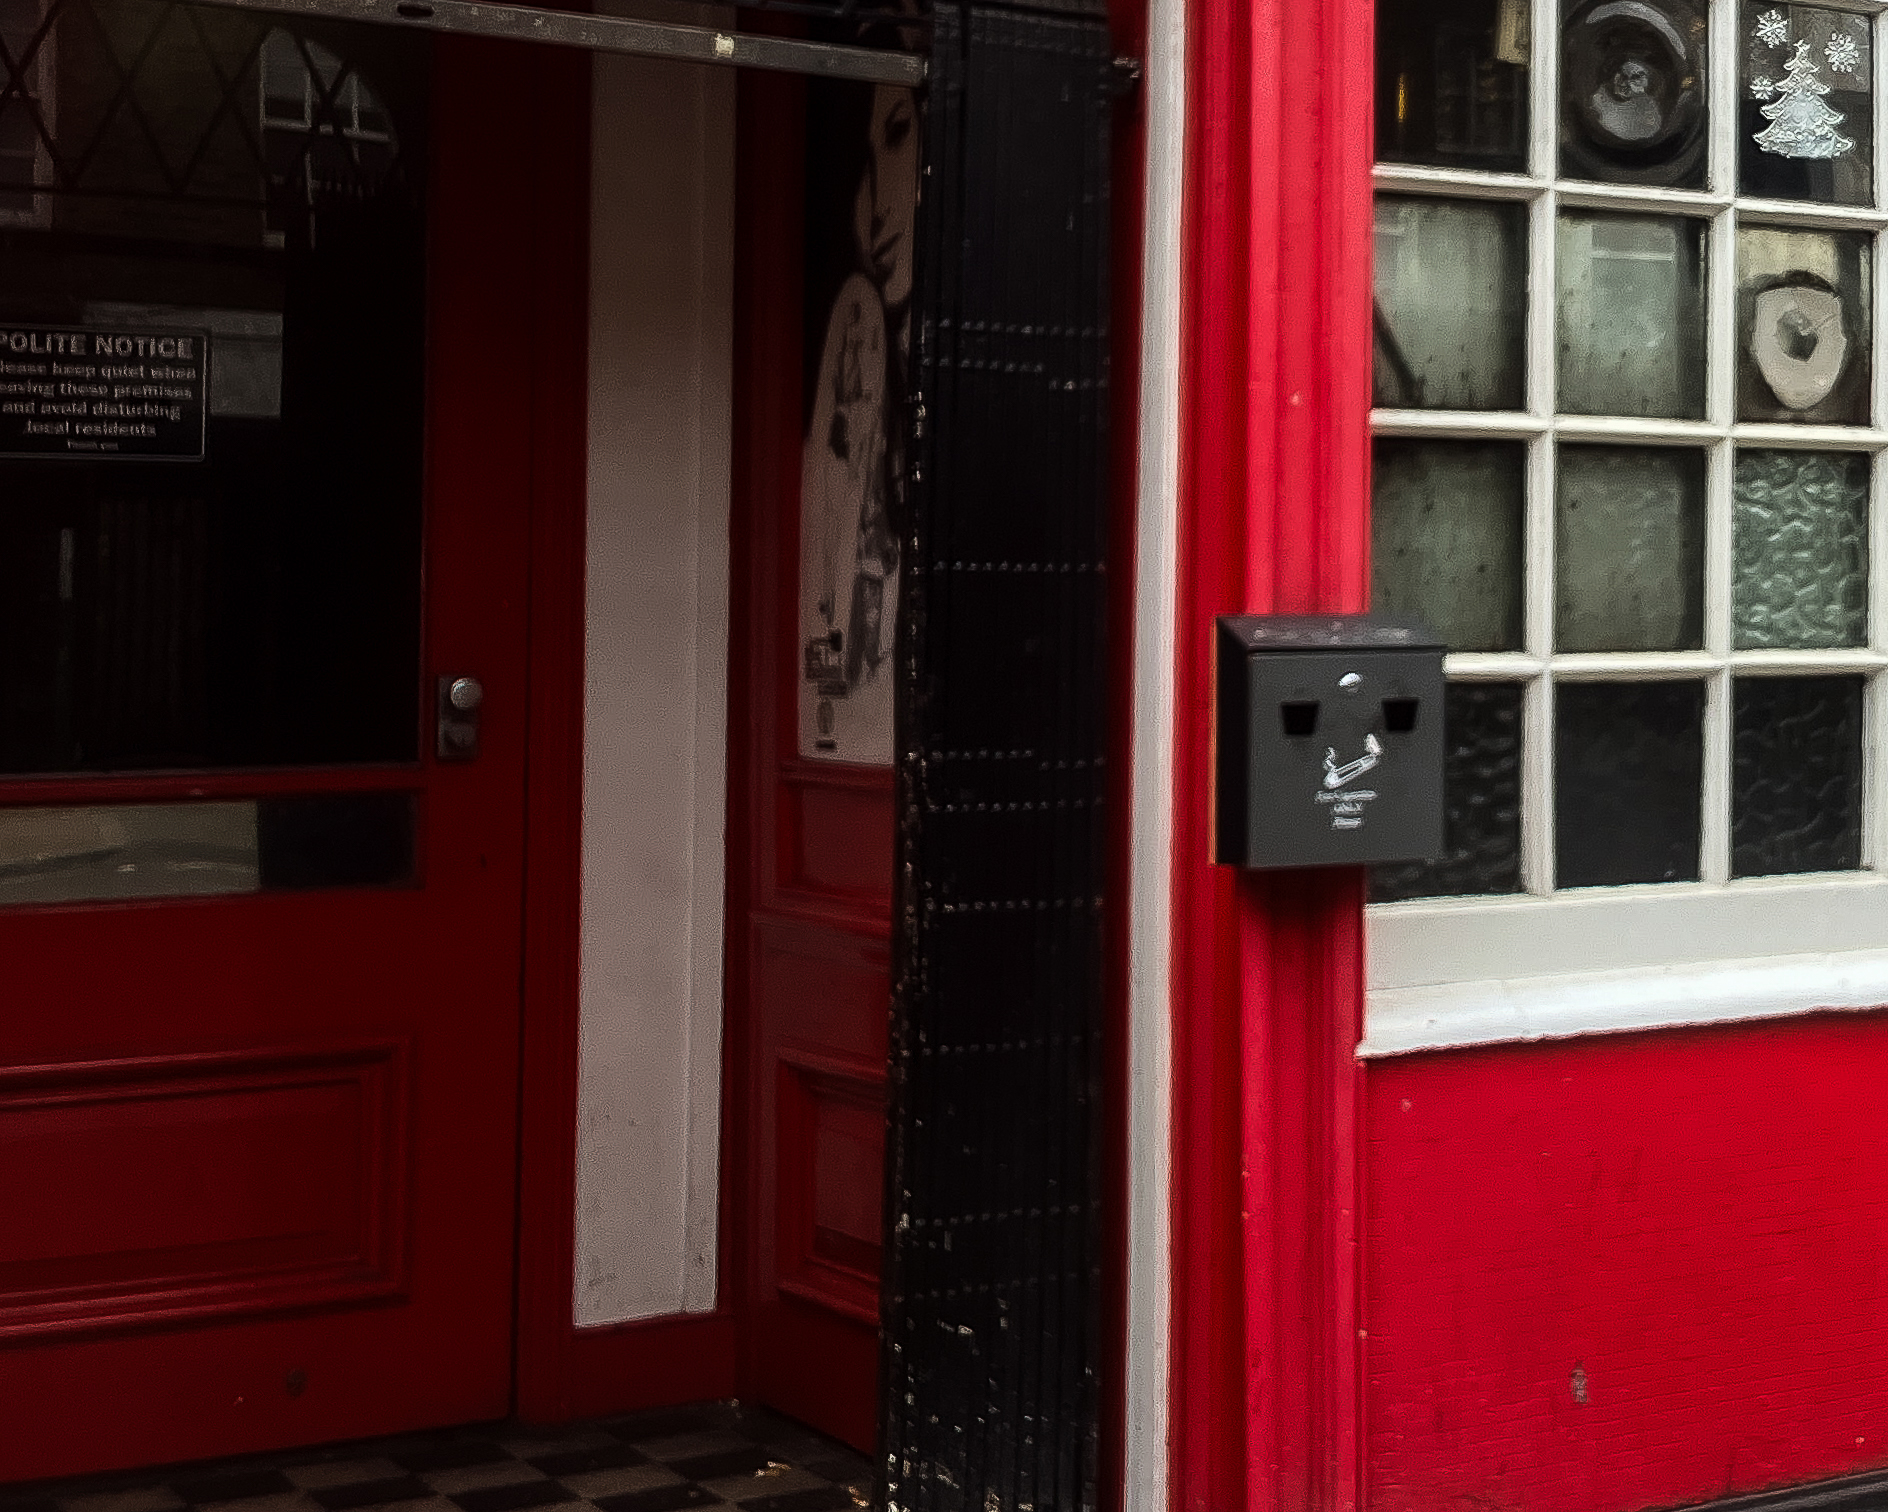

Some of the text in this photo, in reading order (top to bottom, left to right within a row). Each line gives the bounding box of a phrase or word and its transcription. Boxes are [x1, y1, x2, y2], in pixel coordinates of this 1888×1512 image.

[95, 334, 194, 360] NOTICE
[0, 359, 47, 376] lease
[52, 360, 97, 380] keep
[100, 364, 145, 381] quiet
